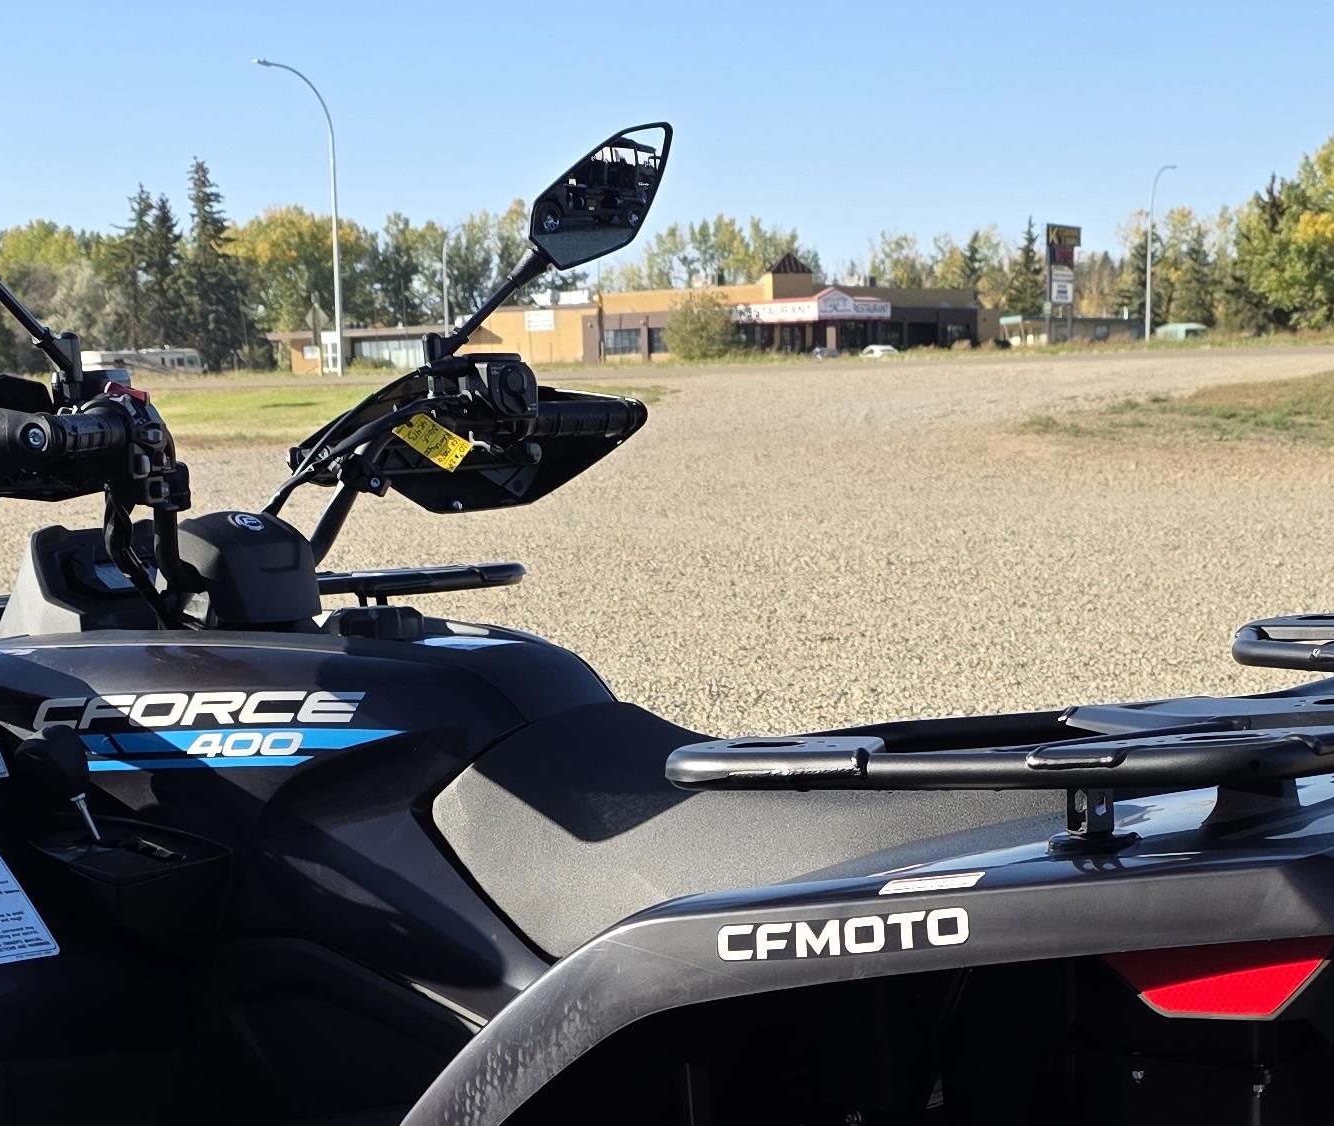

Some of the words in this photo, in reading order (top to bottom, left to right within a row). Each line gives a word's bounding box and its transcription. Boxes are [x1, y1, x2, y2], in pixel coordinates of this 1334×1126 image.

[32, 690, 366, 730] CFORCE
[187, 732, 305, 758] 400
[717, 907, 969, 961] CFMOTO
